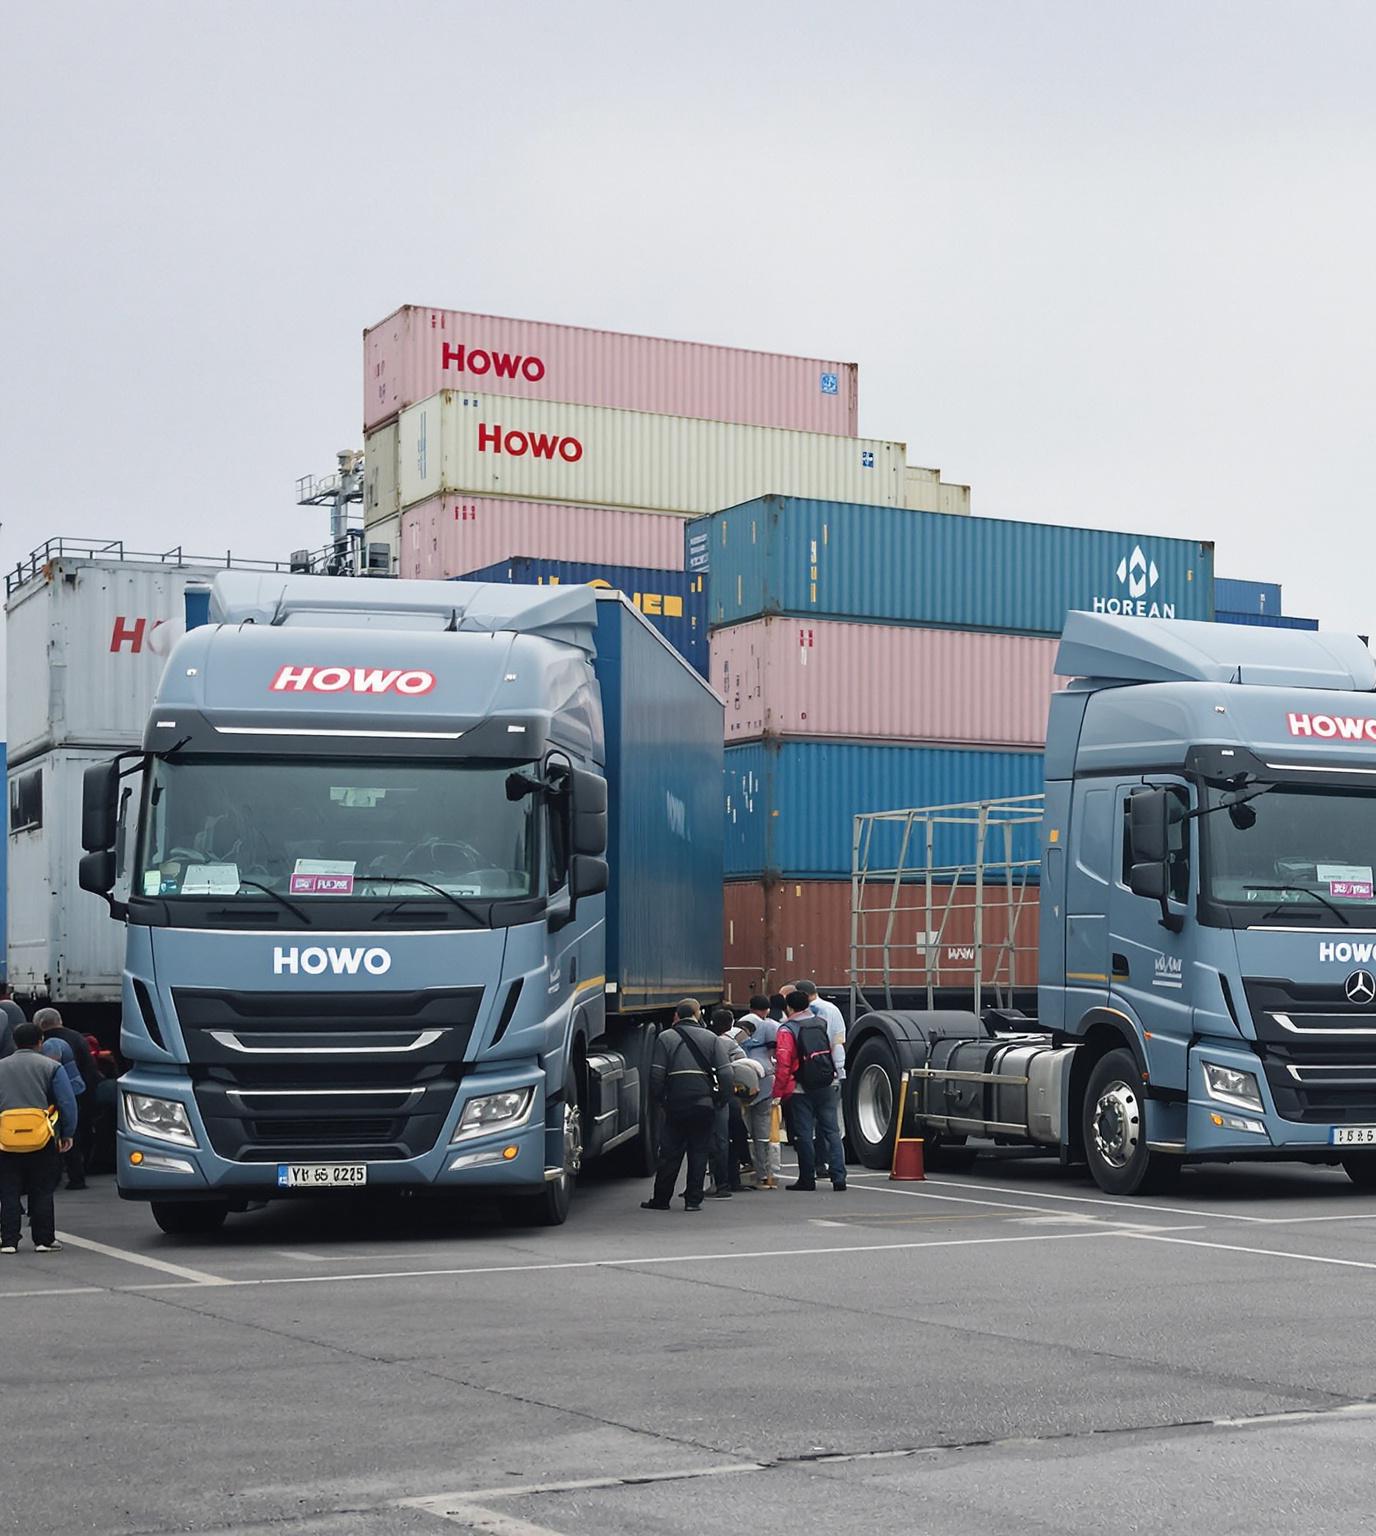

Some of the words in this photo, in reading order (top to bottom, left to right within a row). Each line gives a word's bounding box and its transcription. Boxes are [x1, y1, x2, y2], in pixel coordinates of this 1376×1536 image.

[442, 342, 545, 382] HOWO
[478, 423, 583, 463] HOWO
[1093, 597, 1175, 619] HOREAN
[110, 616, 167, 656] H
[274, 665, 433, 694] HOWO
[273, 946, 392, 975] HOWO
